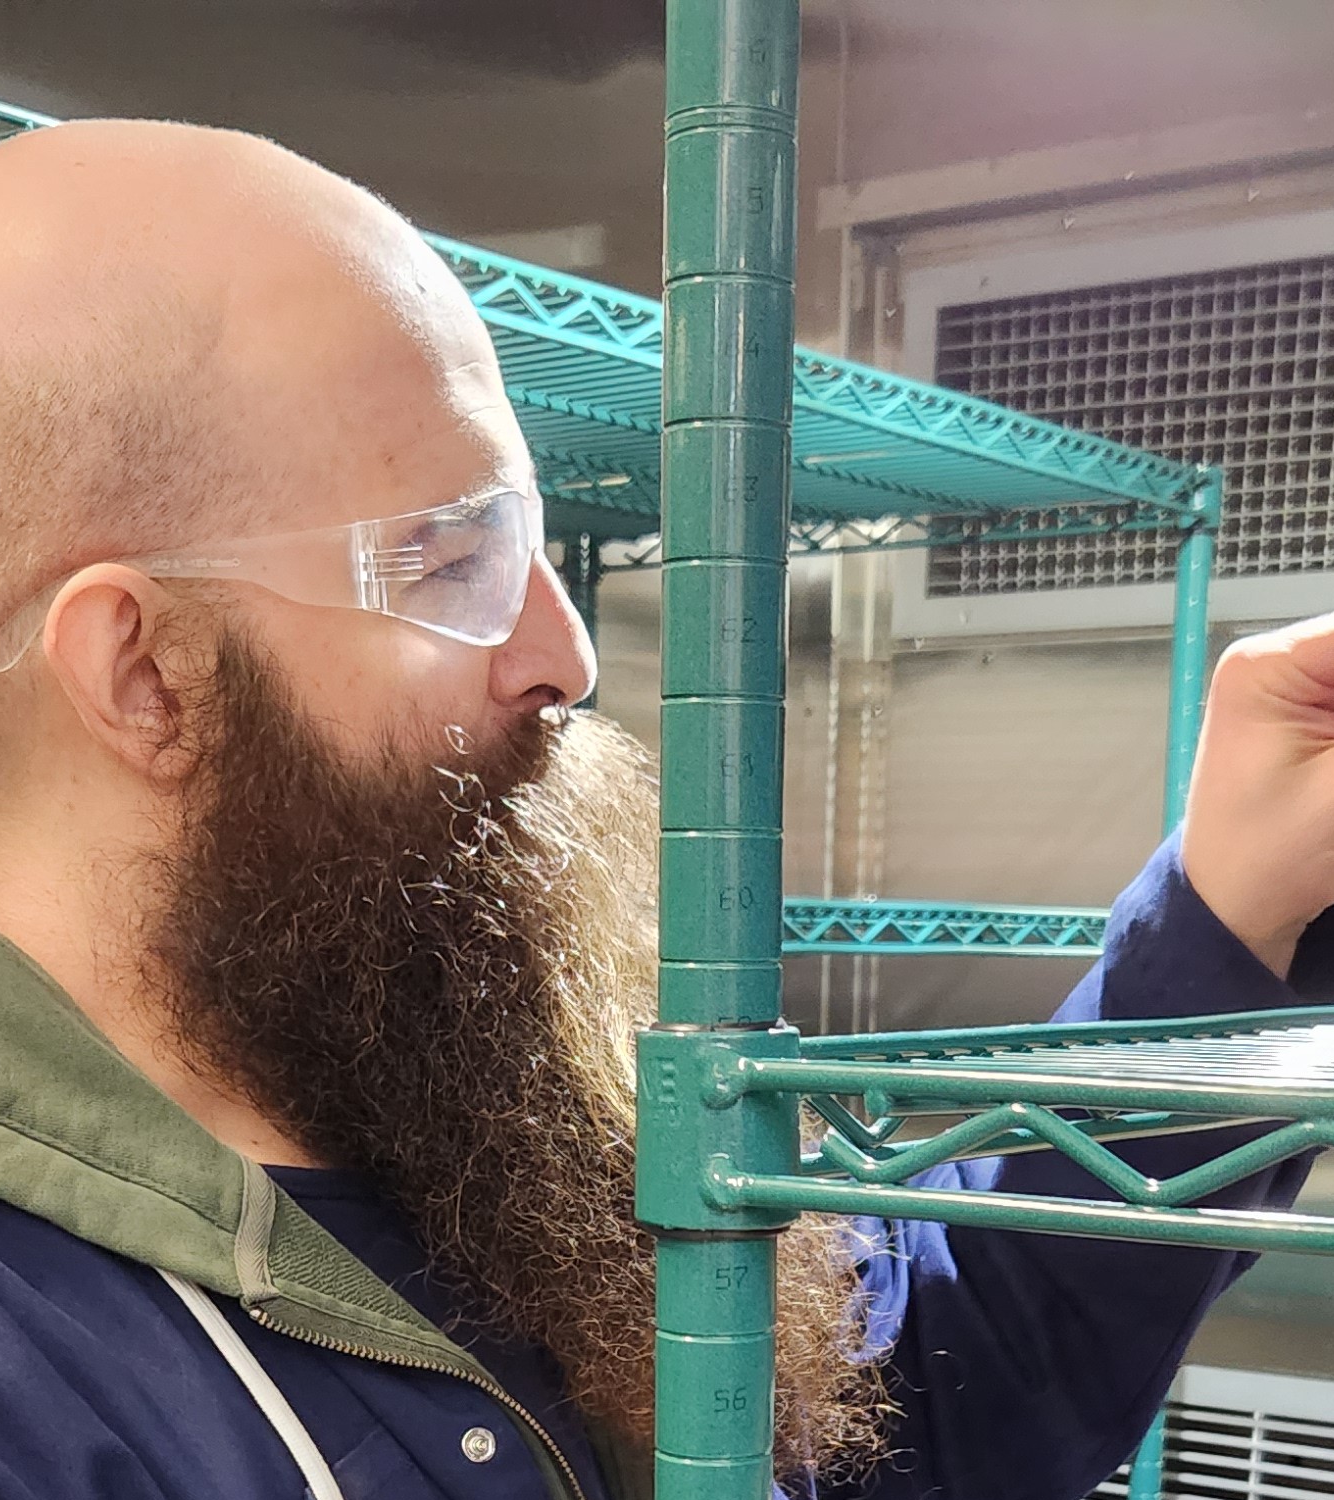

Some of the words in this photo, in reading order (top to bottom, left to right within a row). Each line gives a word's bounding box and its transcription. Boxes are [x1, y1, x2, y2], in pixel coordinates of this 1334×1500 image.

[721, 617, 757, 643] 62
[715, 1265, 748, 1291] 57
[713, 1386, 747, 1413] 56
